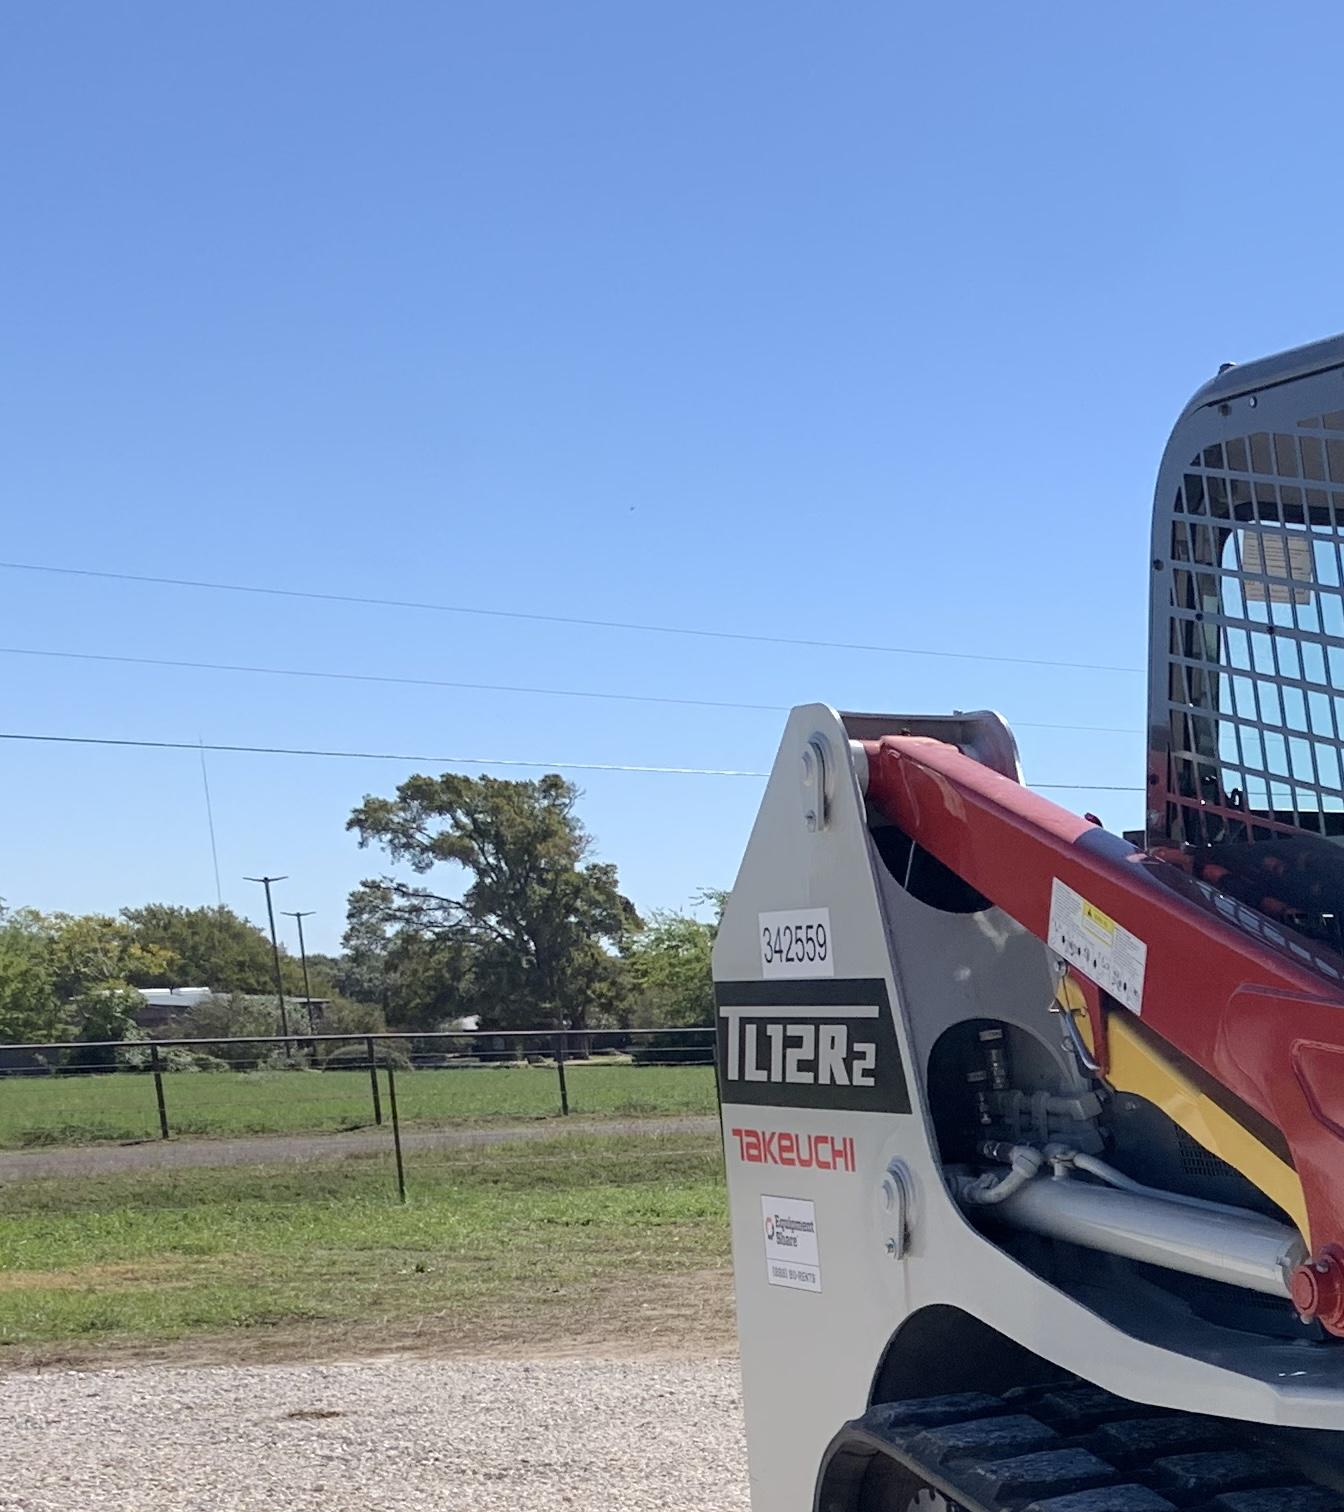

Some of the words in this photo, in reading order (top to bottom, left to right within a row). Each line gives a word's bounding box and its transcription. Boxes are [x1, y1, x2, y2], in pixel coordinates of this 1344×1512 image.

[762, 923, 827, 963] 342559
[720, 1006, 879, 1087] TL12R2
[732, 1128, 856, 1172] TAKEUCHI
